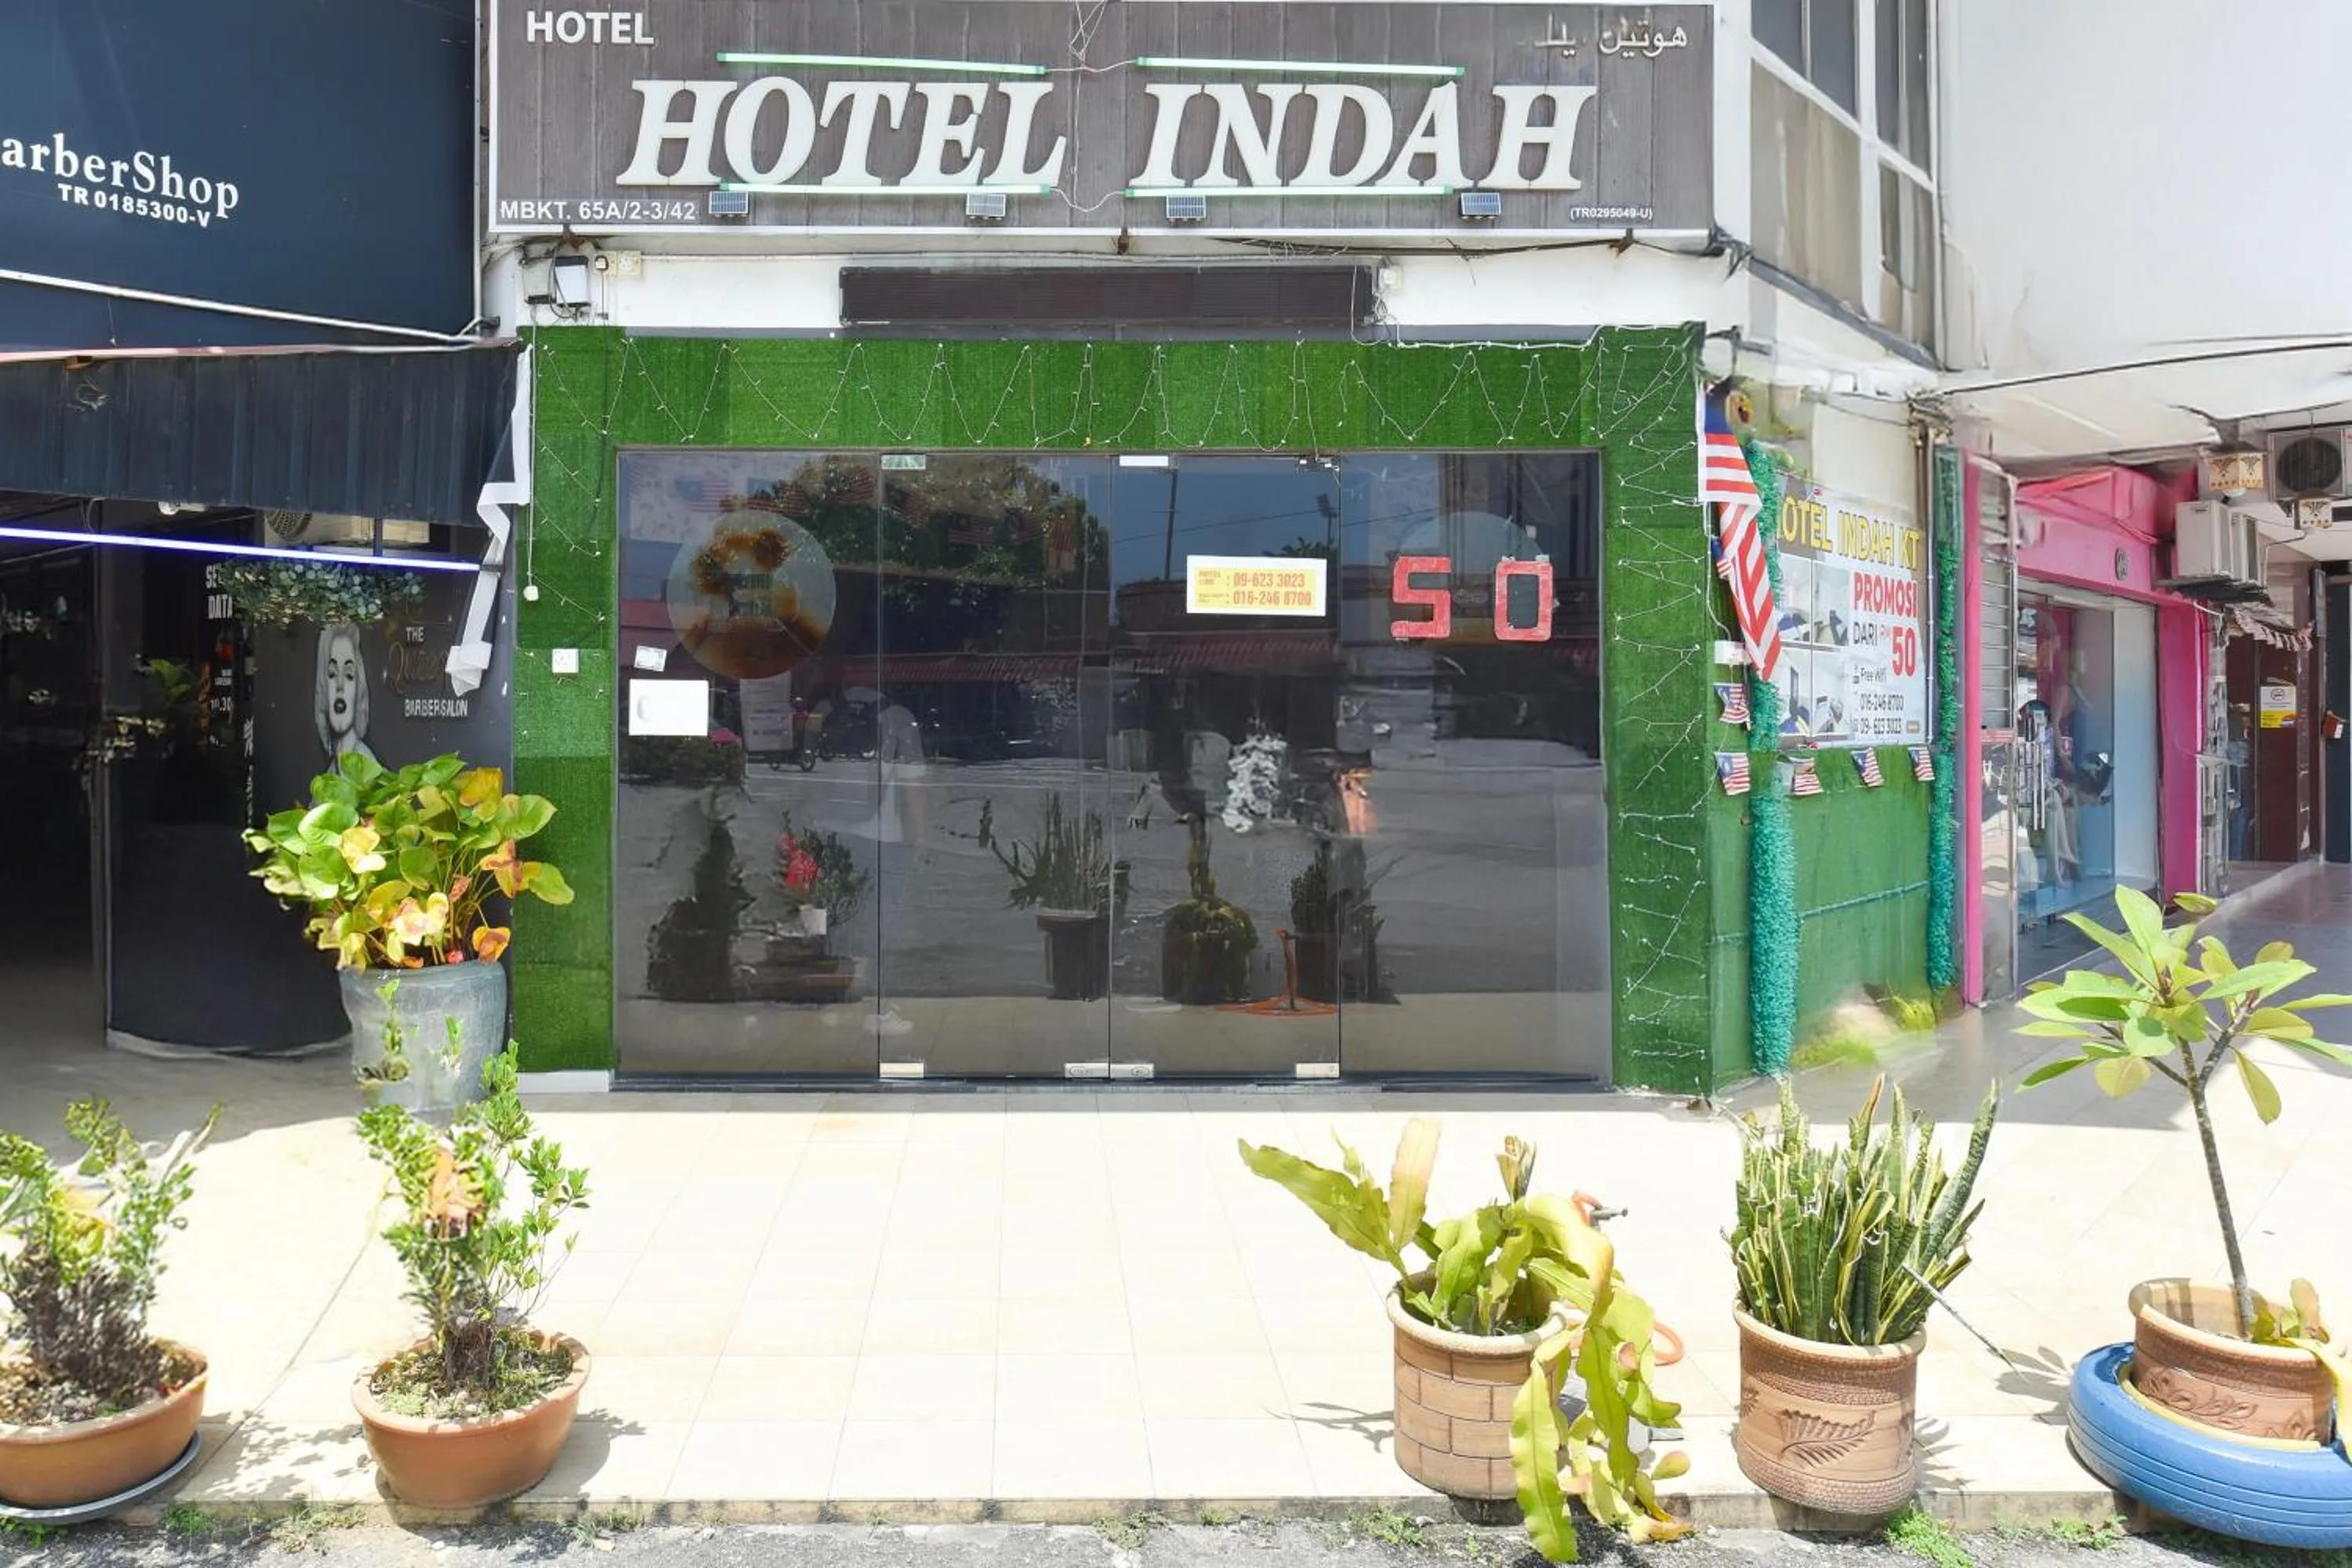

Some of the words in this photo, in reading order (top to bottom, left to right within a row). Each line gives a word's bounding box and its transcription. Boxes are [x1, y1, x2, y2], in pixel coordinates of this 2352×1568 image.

[526, 12, 654, 45] HOTEL
[616, 76, 1066, 186] HOTEL
[1128, 80, 1596, 190] INDAH
[2, 132, 238, 219] arberShop
[58, 183, 89, 205] TR
[93, 191, 210, 227] 0185300-V
[500, 201, 571, 220] MBKT.
[579, 201, 696, 220] 65A/2-3/42
[1777, 495, 1832, 552] OTEL
[1837, 510, 1895, 566] INDAH
[1278, 573, 1305, 587] 3023
[405, 627, 425, 642] THE
[1853, 621, 1878, 646] DARI
[1893, 626, 1917, 677] 50
